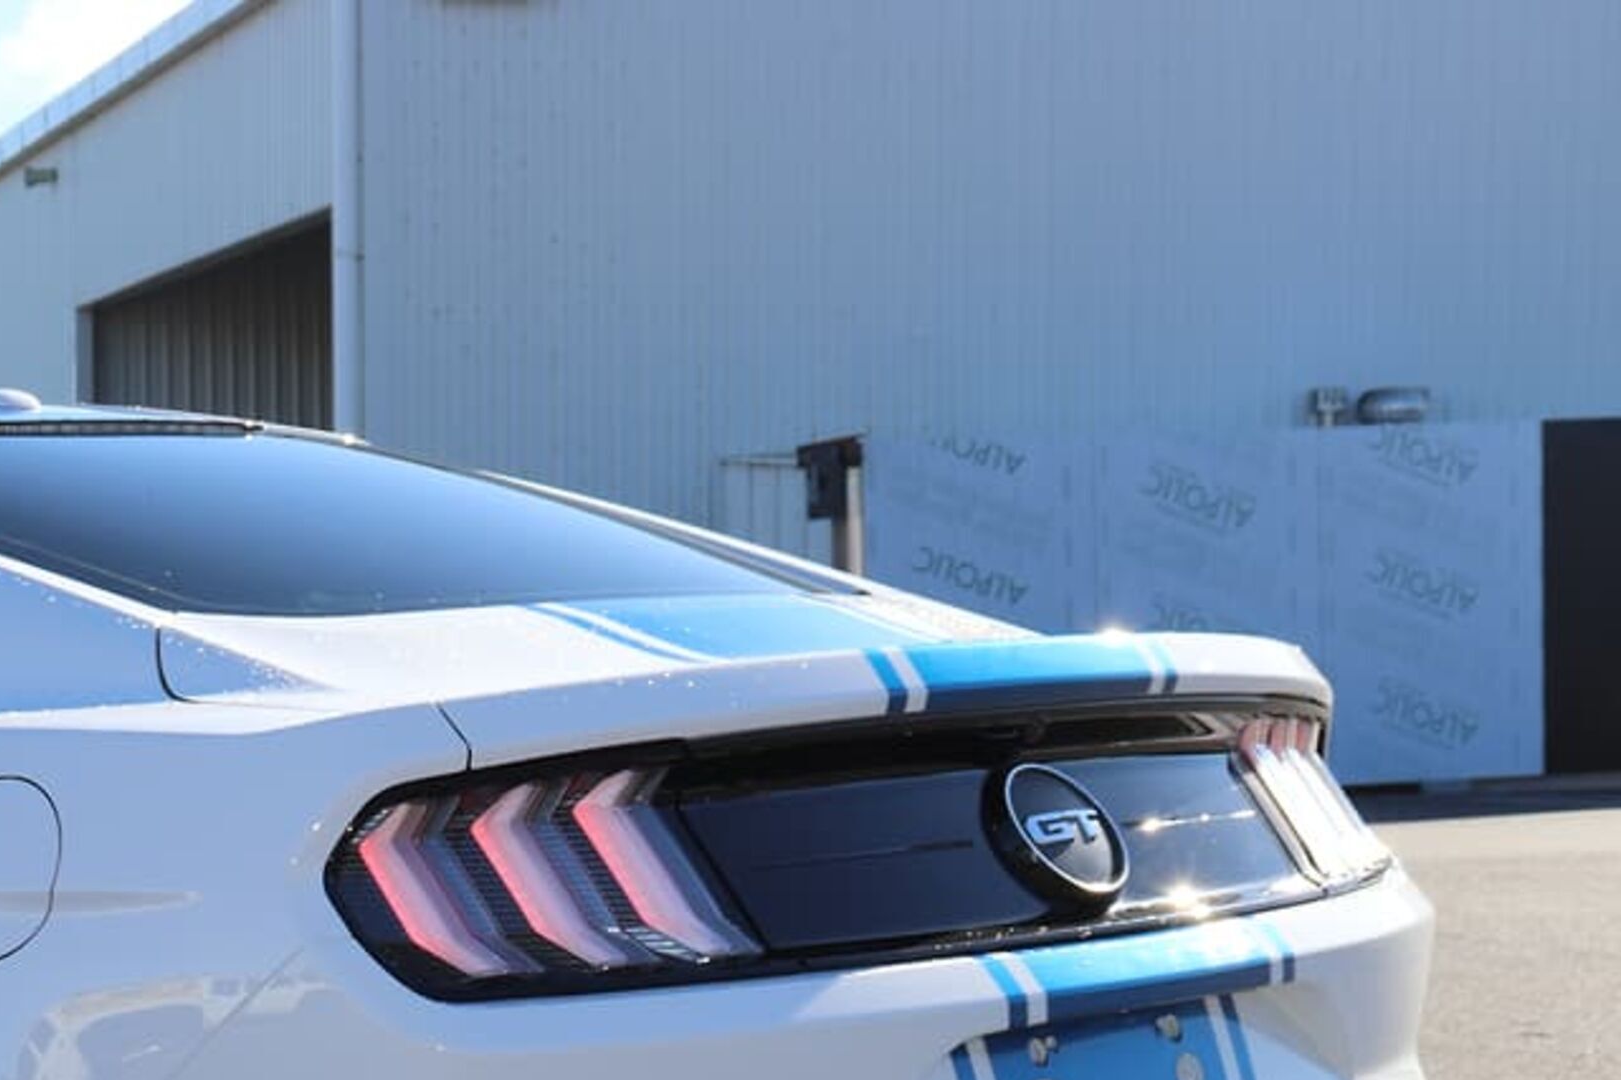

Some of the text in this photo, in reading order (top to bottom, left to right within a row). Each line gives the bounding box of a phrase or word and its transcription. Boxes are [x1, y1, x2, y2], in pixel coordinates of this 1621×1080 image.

[1141, 463, 1257, 528] ALPOLIC
[912, 545, 1029, 604] ALPOLIC
[1364, 552, 1479, 614] ALPOLIC
[1366, 680, 1479, 745] ALPOLIC
[1025, 808, 1099, 845] GT
